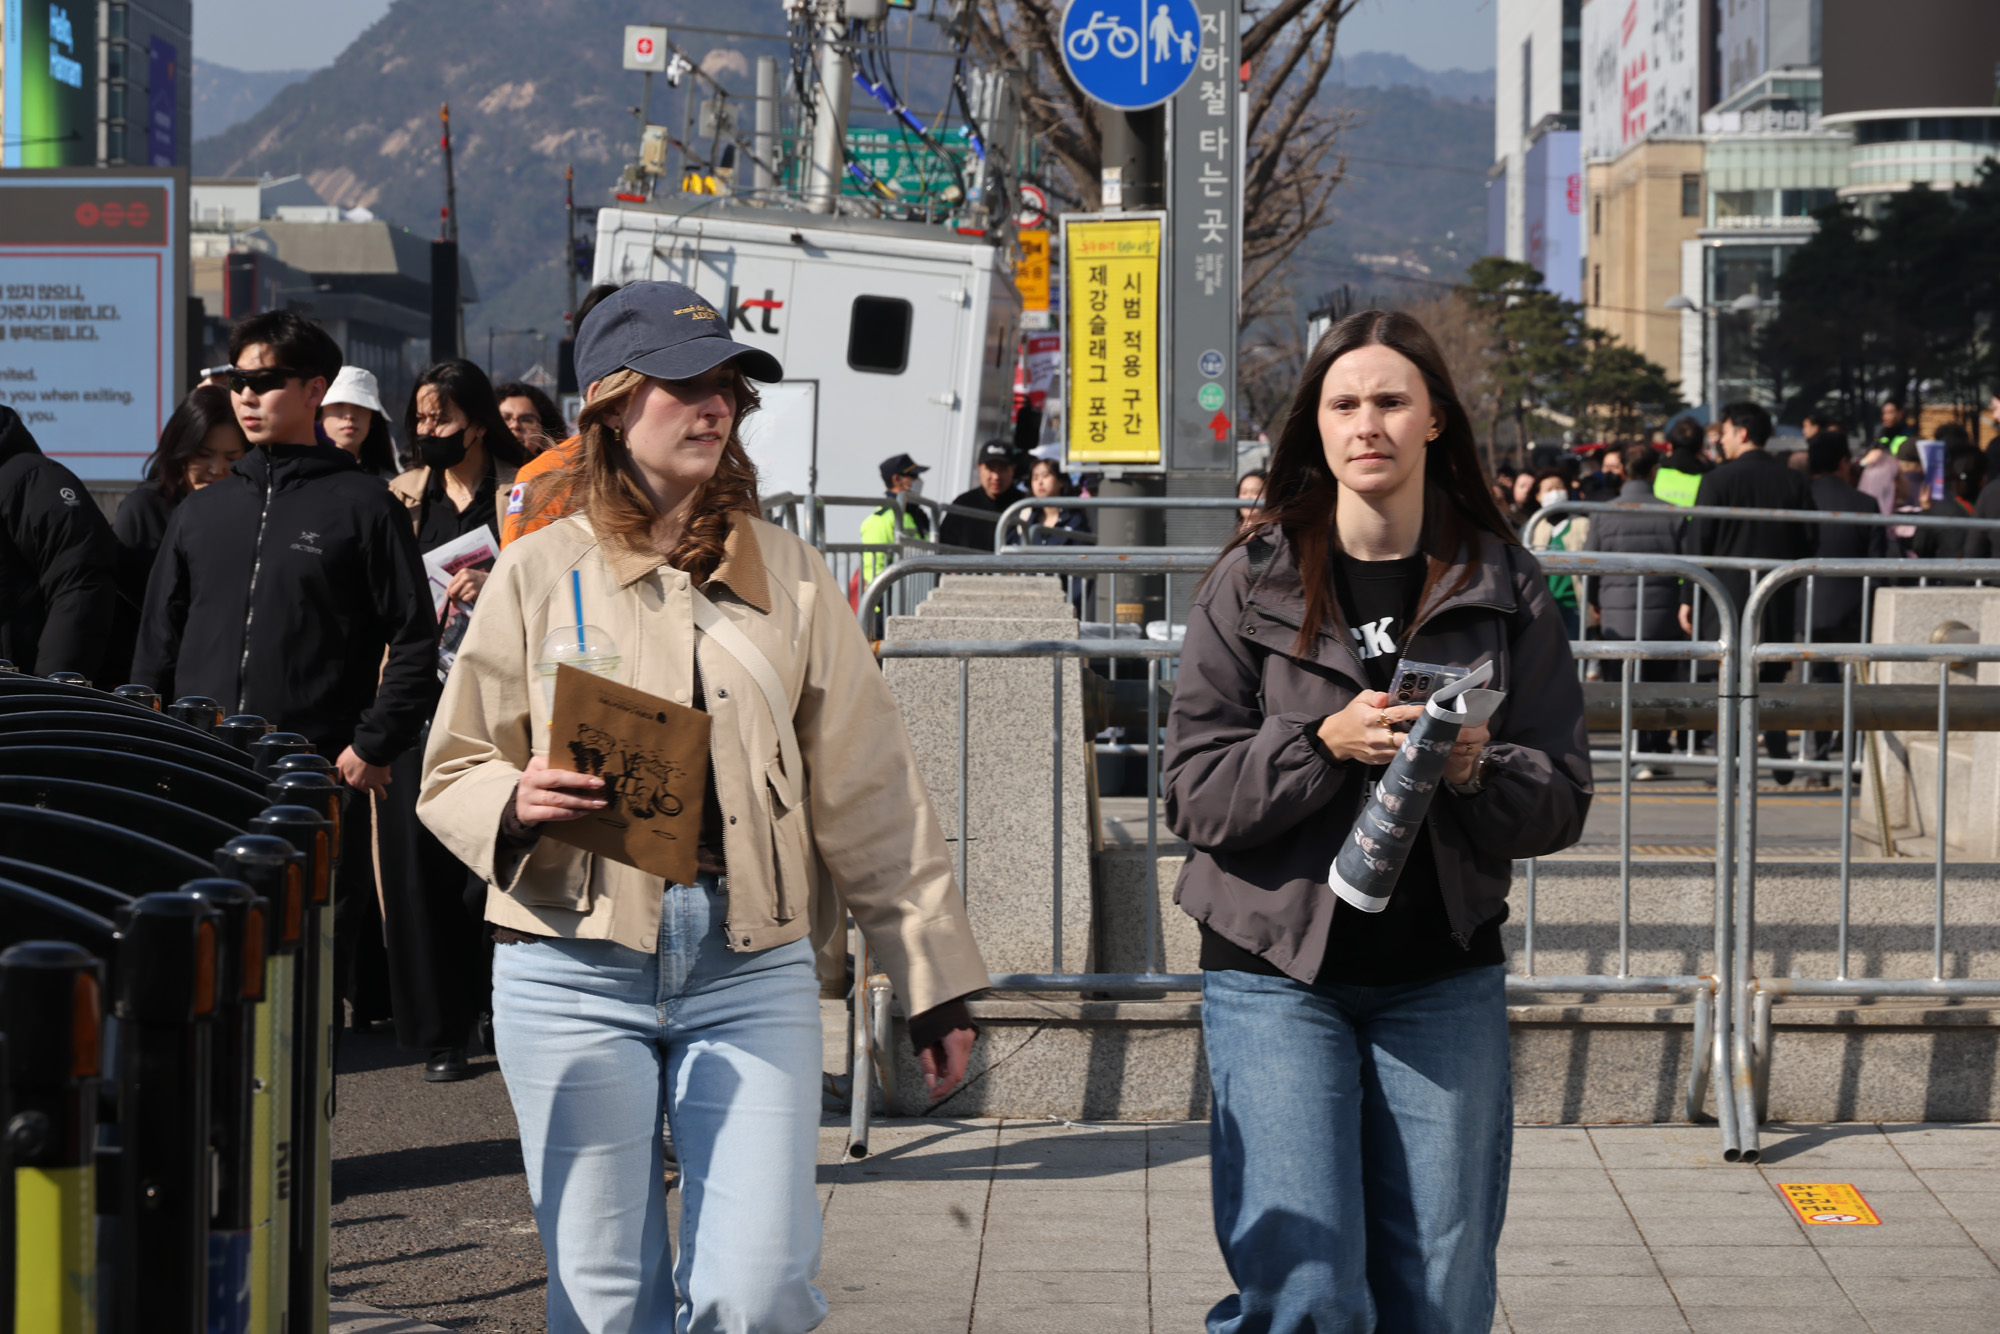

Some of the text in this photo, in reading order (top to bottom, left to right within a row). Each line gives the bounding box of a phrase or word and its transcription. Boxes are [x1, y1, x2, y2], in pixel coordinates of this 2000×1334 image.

[1198, 11, 1229, 243] 지하철 타는 곳
[727, 286, 784, 334] kt
[1088, 264, 1108, 442] 제강슬래그 포장
[1122, 272, 1142, 435] 시범 적용 구간
[9, 390, 36, 405] you
[40, 387, 79, 401] when
[83, 387, 134, 405] exiting.
[27, 411, 57, 424] you.
